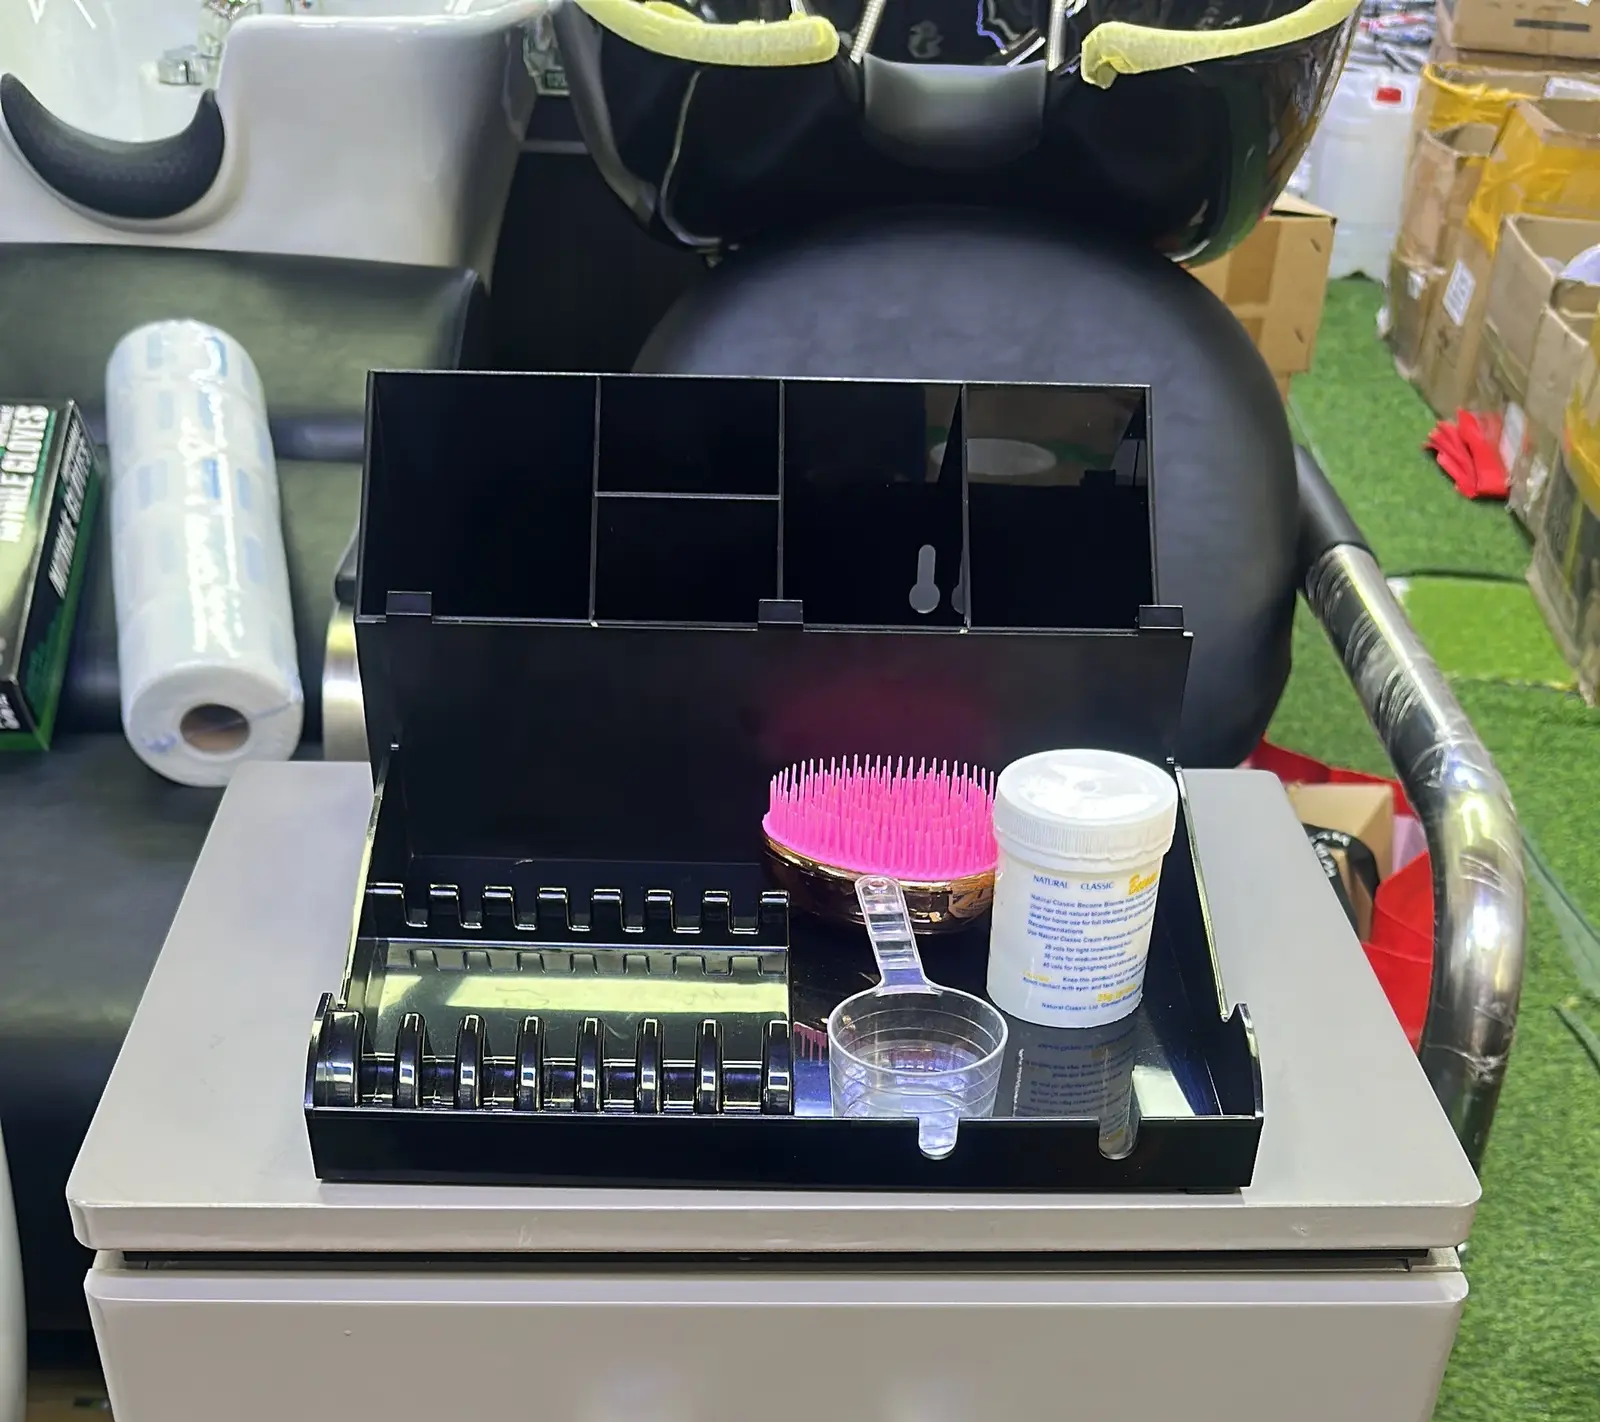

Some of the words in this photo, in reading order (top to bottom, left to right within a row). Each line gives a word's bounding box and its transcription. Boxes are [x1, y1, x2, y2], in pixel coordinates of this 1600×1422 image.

[1, 405, 49, 474] GLOVES
[1033, 874, 1068, 889] NATURAL
[1080, 881, 1115, 891] CLASSIC
[1041, 1001, 1064, 1010] Natural
